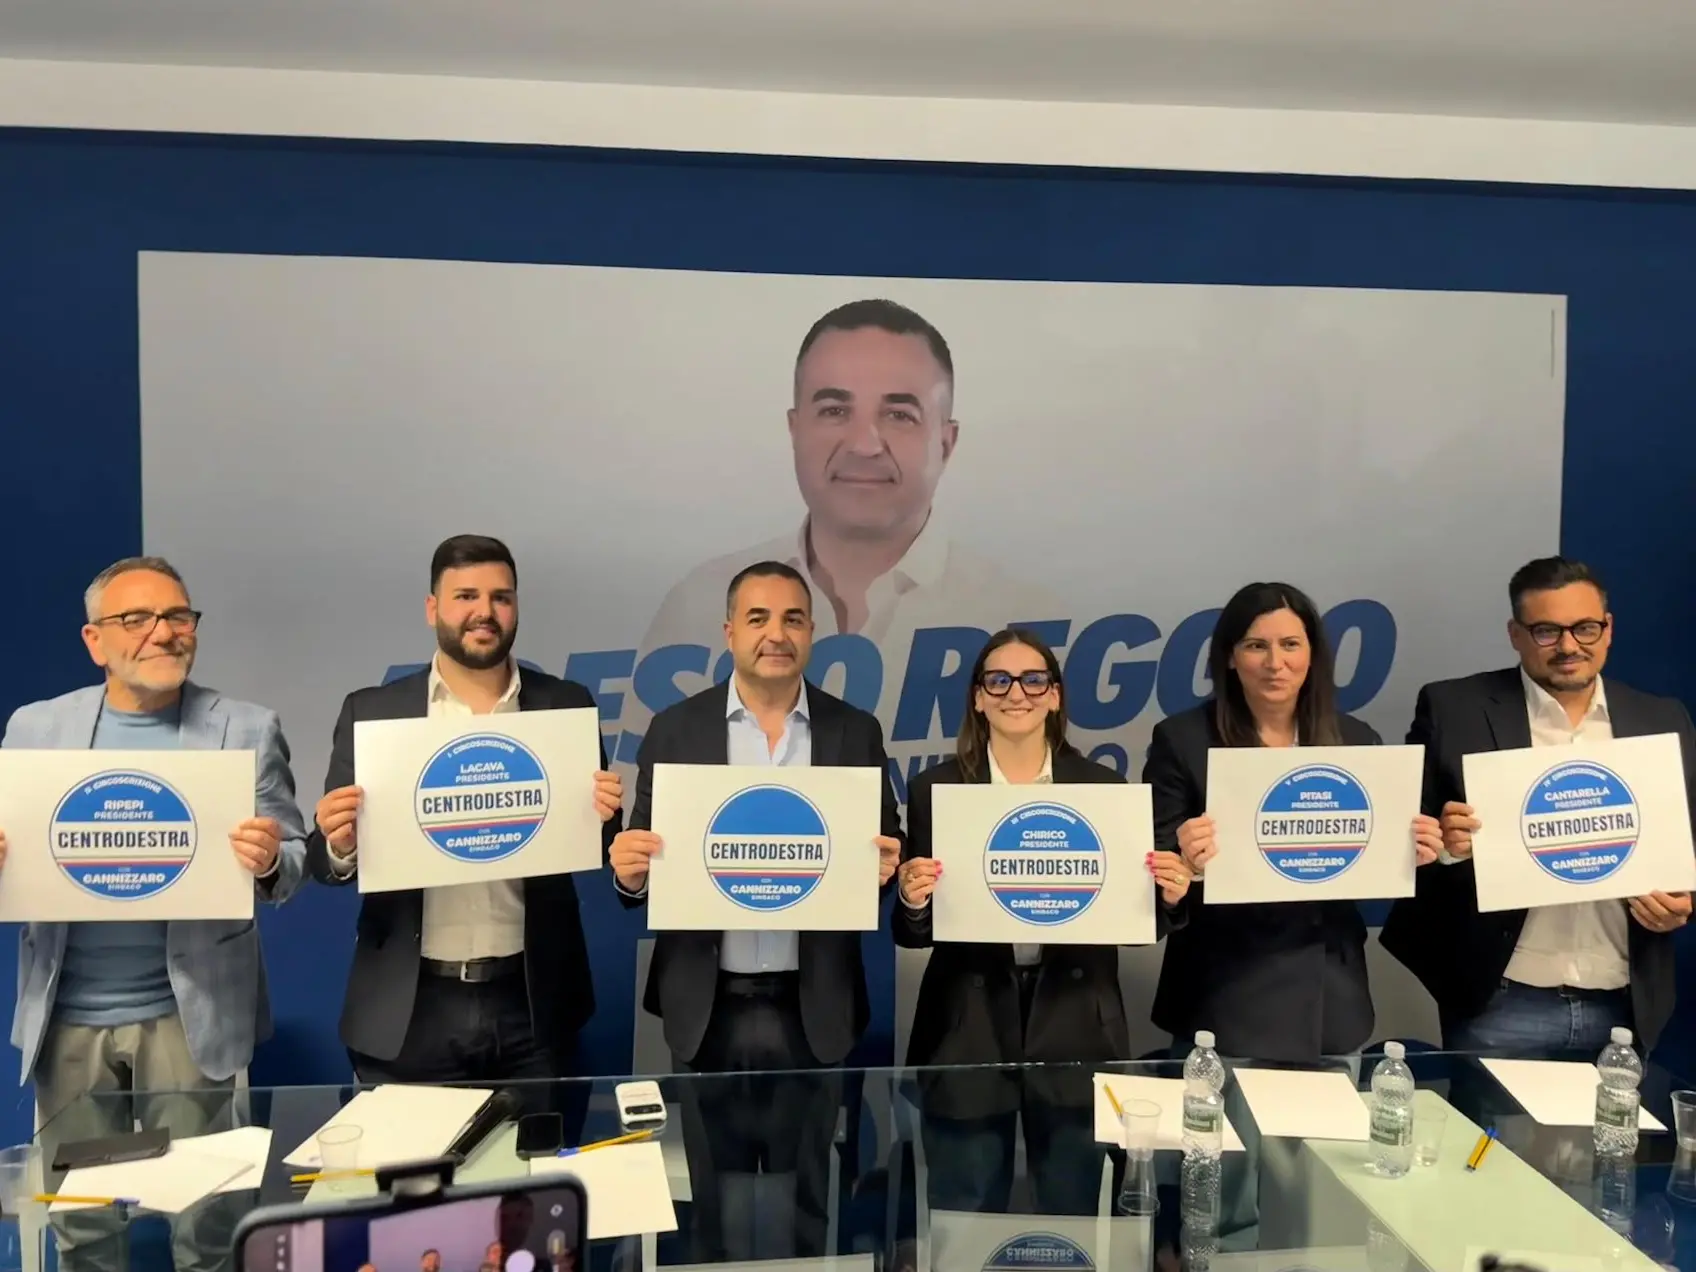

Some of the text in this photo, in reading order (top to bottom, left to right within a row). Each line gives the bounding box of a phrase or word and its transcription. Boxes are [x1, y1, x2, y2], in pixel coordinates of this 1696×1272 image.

[460, 761, 505, 774] LACAVA
[455, 772, 510, 783] PRESIDENTE
[1300, 791, 1332, 800] PITASI
[1544, 786, 1611, 802] CANTARELLA
[104, 800, 144, 811] RIPEPI
[422, 788, 543, 815] CENTRODESTRA
[1291, 801, 1340, 809] PRESIDENTE
[1555, 797, 1603, 809] PRESIDENTE
[94, 811, 154, 820] PRESIDENTE
[1261, 818, 1367, 836] CENTRODESTRA
[1528, 812, 1635, 839] CENTRODESTRA
[58, 830, 190, 849] CENTRODESTRA
[446, 832, 522, 848] CANNIZZARO
[1022, 830, 1067, 840] CHIRICO
[1019, 840, 1069, 848] PRESIDENTE
[711, 842, 823, 860] CENTRODESTRA
[990, 858, 1100, 876] CENTRODESTRA
[1279, 856, 1346, 868] CANNIZZARO
[1552, 854, 1619, 870] CANNIZZARO
[82, 873, 166, 885] CANNIZZARO
[730, 884, 802, 894] CANNIZZARO
[1010, 899, 1080, 909] CANNIZZARO
